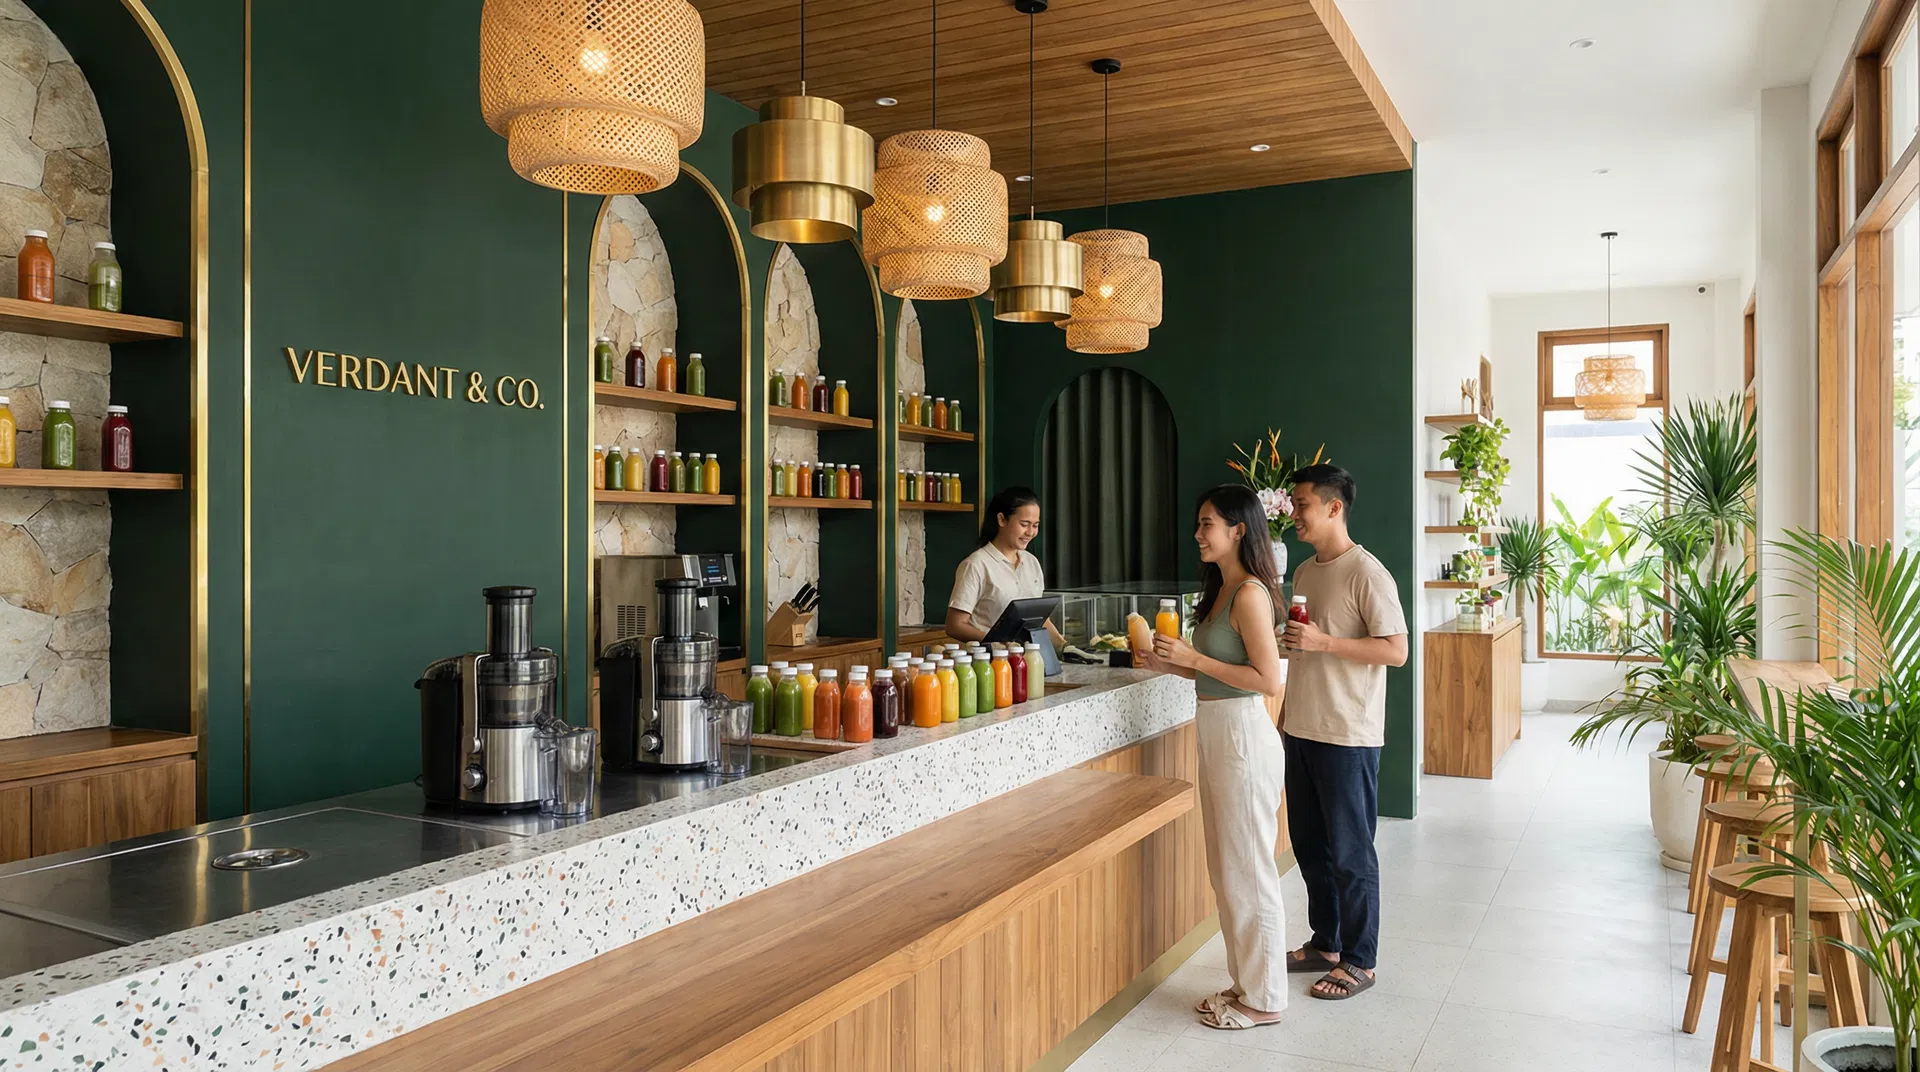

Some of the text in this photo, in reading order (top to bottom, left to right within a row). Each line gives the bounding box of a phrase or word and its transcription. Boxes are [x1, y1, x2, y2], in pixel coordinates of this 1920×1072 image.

[286, 347, 545, 410] VERDANT & CO.
